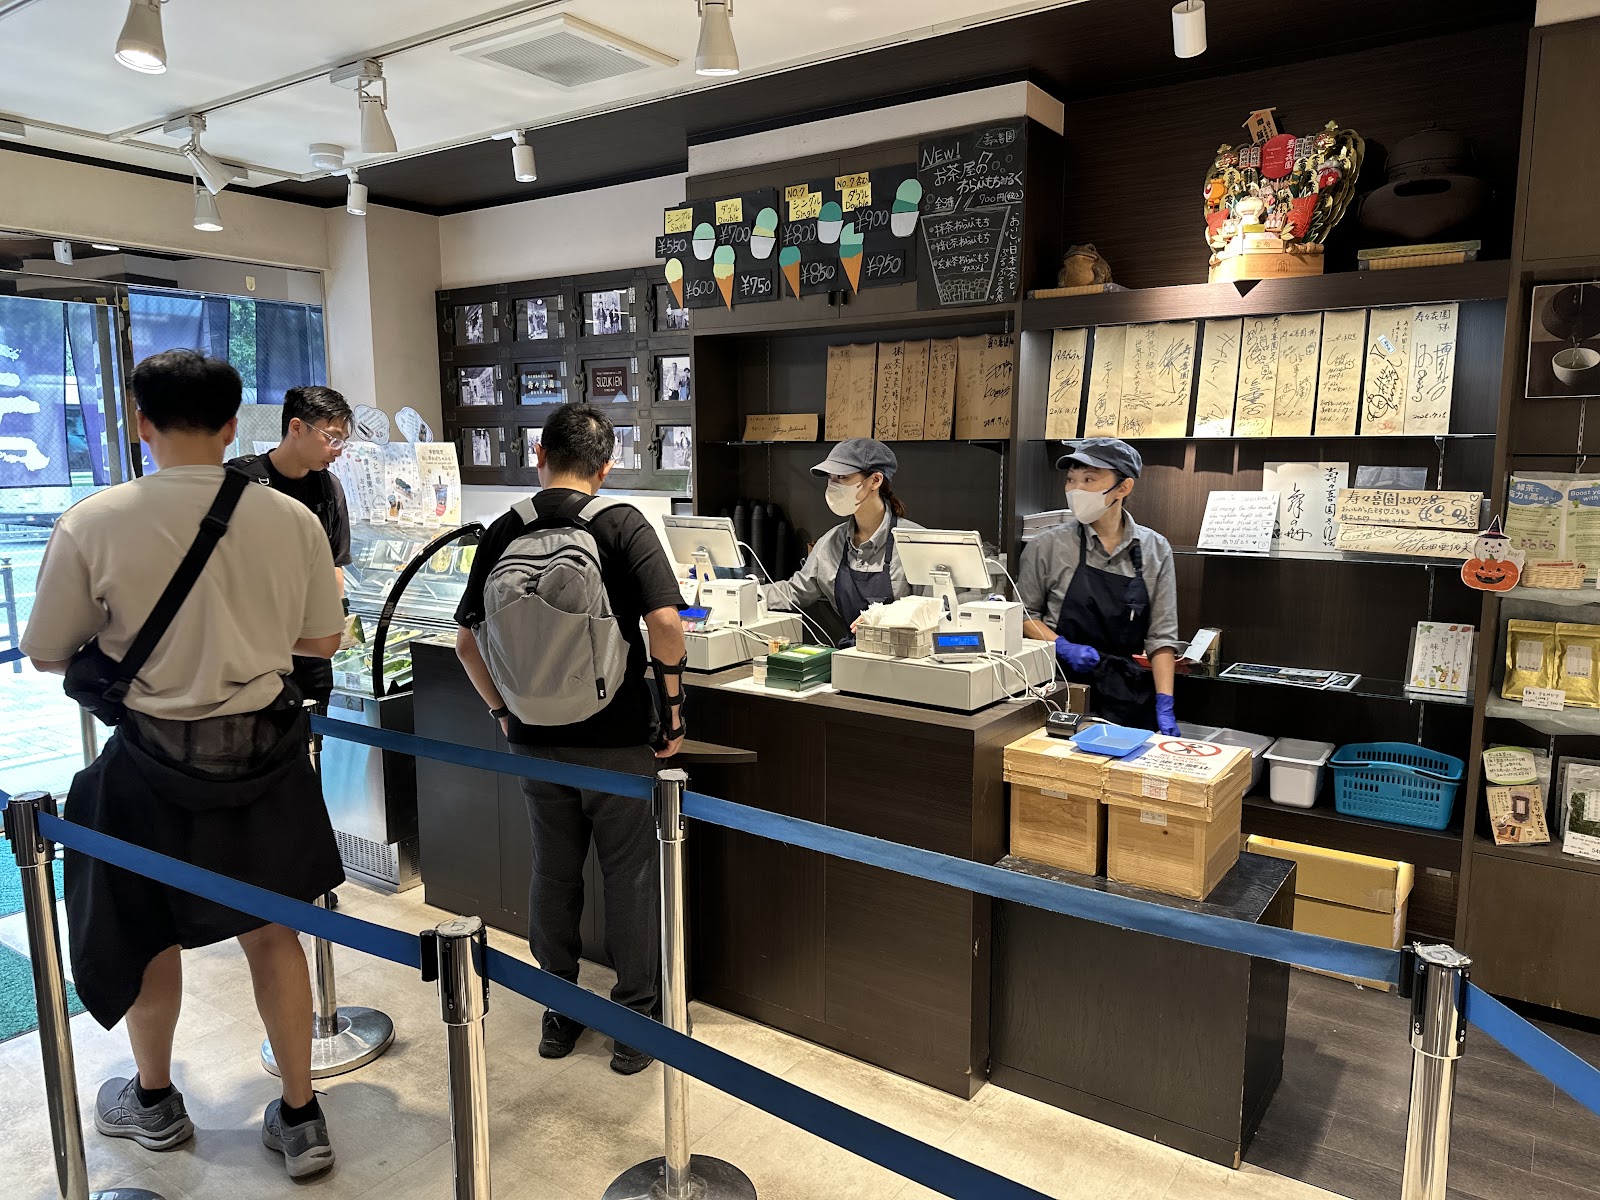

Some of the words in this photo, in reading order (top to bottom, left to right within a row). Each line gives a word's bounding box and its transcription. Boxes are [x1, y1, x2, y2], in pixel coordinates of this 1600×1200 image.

[921, 141, 961, 168] NEW!
[793, 195, 821, 209] シングル
[847, 188, 870, 202] ダブル
[667, 211, 692, 223] シングル
[720, 203, 740, 214] ダブル
[795, 208, 817, 219] Single
[670, 222, 687, 232] Single
[717, 214, 739, 224] Double
[855, 208, 889, 231] ¥900
[719, 225, 751, 245] ¥700
[783, 223, 817, 245] ¥800
[657, 238, 687, 255] ¥550
[801, 262, 836, 285] ¥850
[866, 253, 902, 277] ¥950
[685, 279, 715, 300] ¥600
[741, 274, 772, 296] ¥750
